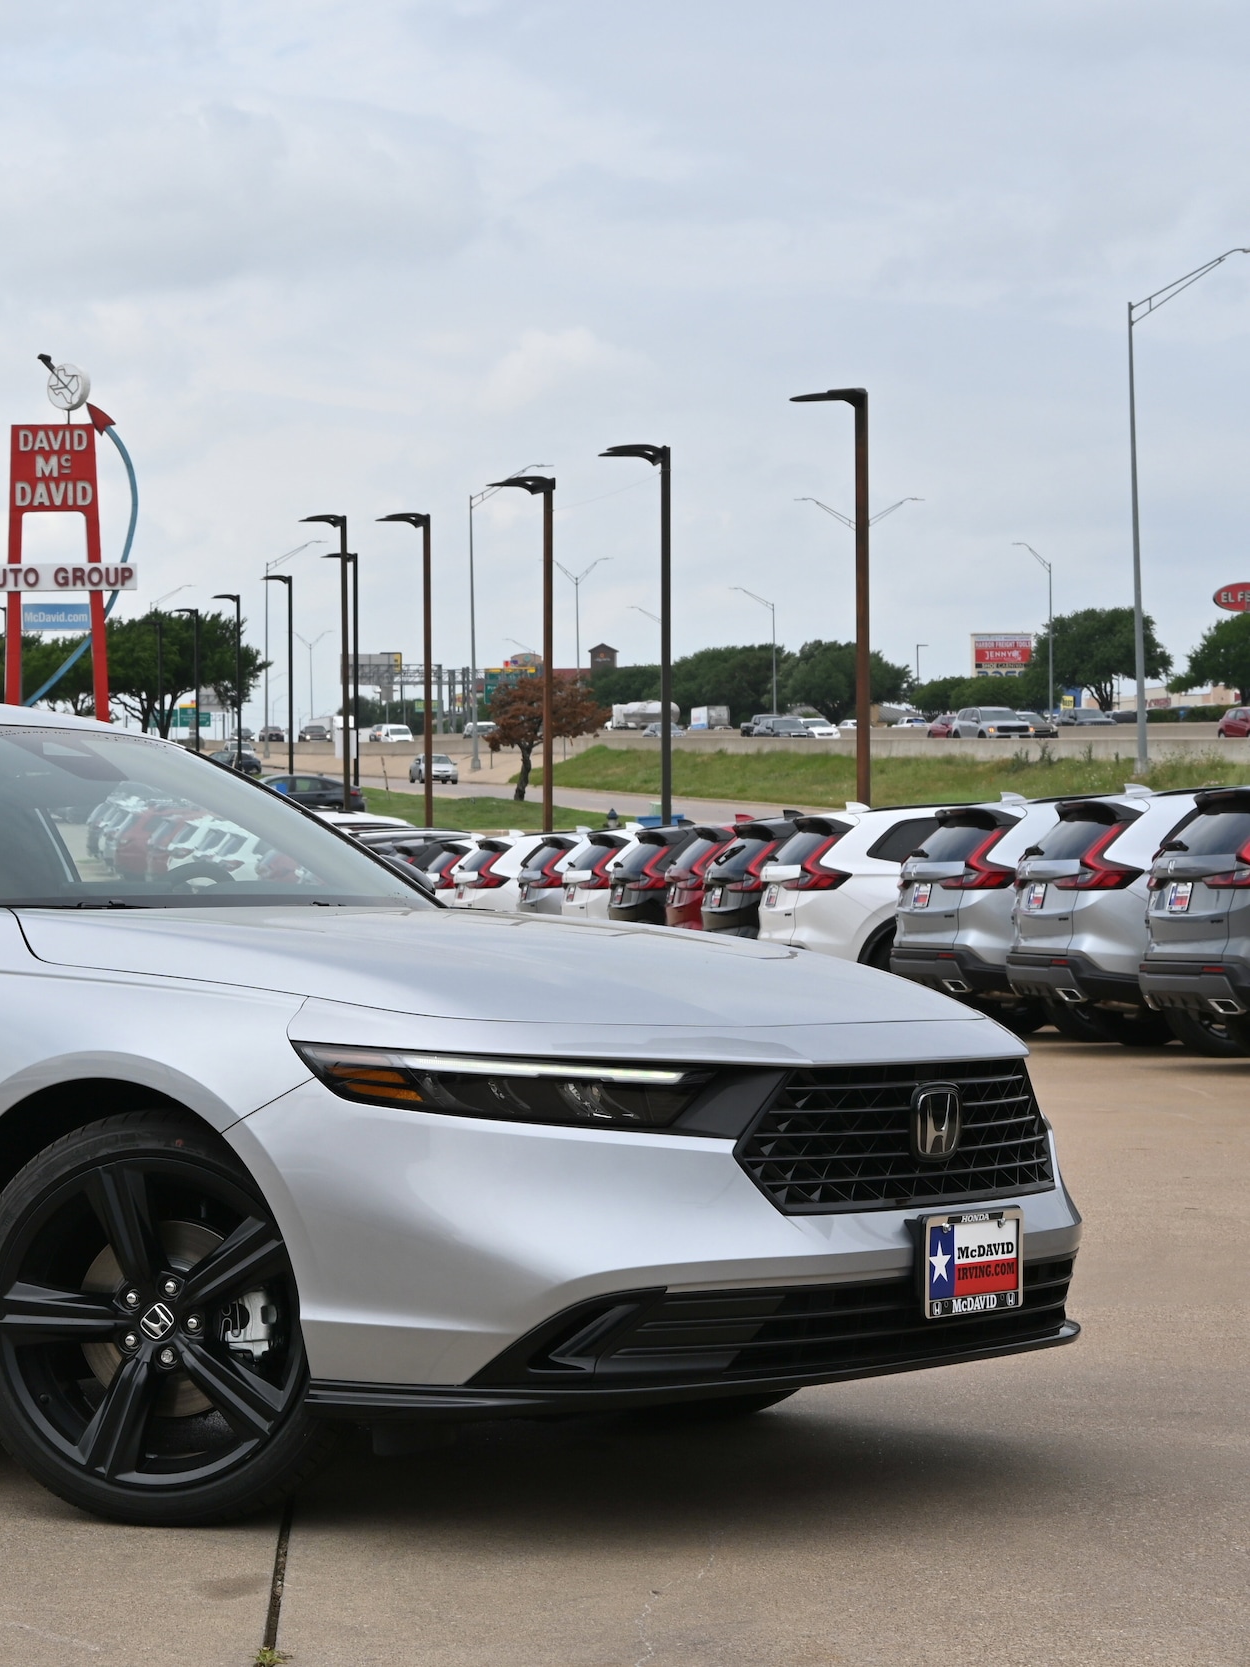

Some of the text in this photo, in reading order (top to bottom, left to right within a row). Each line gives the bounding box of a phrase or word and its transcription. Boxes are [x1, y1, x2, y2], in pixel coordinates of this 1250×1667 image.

[18, 429, 88, 452] DAVID
[35, 454, 72, 478] Mc
[14, 481, 93, 507] DAVID
[53, 567, 133, 587] GROUP
[1221, 591, 1235, 603] EL
[24, 611, 88, 623] McDavid.com
[985, 650, 1012, 660] JENNY
[961, 1213, 990, 1223] HONDA
[957, 1241, 1014, 1260] McDAVID
[957, 1262, 1014, 1280] IRVING.COM
[952, 1295, 997, 1313] McDAVID
